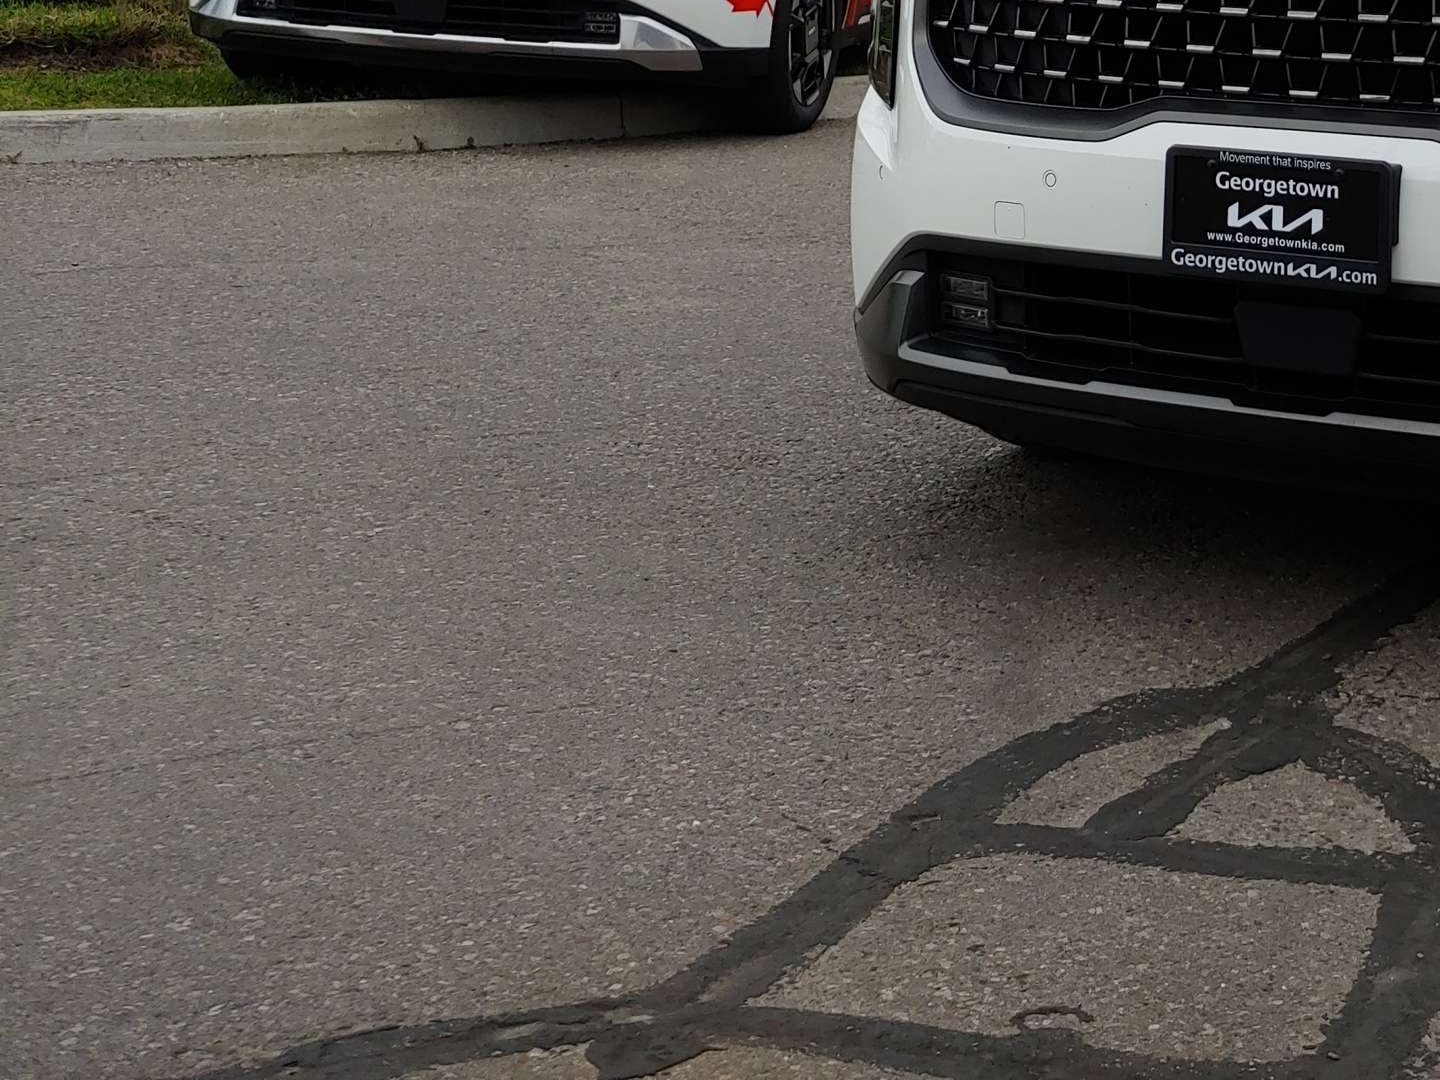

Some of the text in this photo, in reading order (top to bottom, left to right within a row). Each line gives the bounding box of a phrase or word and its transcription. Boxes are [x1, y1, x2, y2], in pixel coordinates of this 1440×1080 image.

[1220, 151, 1331, 170] Movement that inspires
[1215, 172, 1339, 199] Georgetown
[1227, 201, 1324, 235] KIA
[1207, 232, 1345, 253] www.Georgetownkia.com
